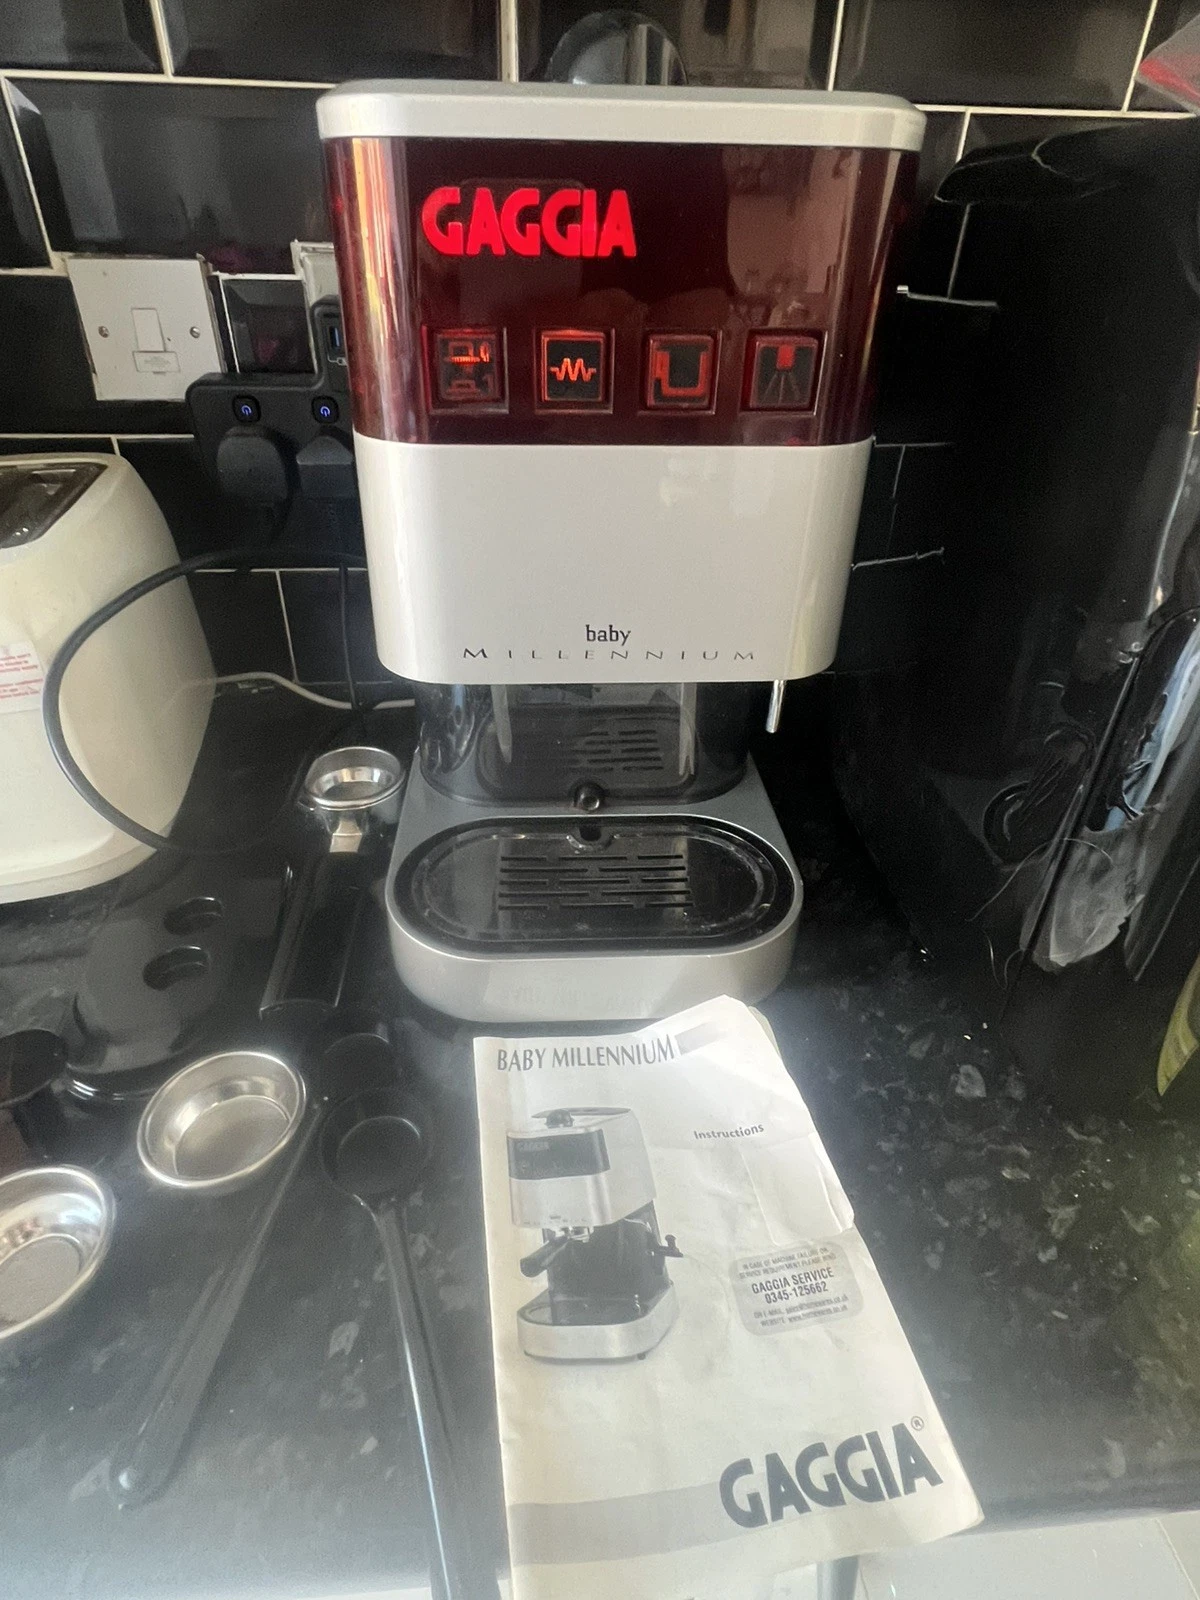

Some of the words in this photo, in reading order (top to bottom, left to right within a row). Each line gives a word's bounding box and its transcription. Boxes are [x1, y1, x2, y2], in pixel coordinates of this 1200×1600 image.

[421, 186, 637, 257] GAGGIA
[585, 624, 631, 646] baby
[463, 648, 754, 660] MILLENNIUM
[497, 1047, 546, 1072] BABY
[551, 1034, 675, 1068] MILLENNIUM
[694, 1123, 765, 1140] Instructions
[751, 1277, 791, 1294] GAGGIA
[791, 1267, 835, 1285] SERVICE
[764, 1281, 829, 1304] 0345-125662
[719, 1422, 944, 1528] GAGGIA
